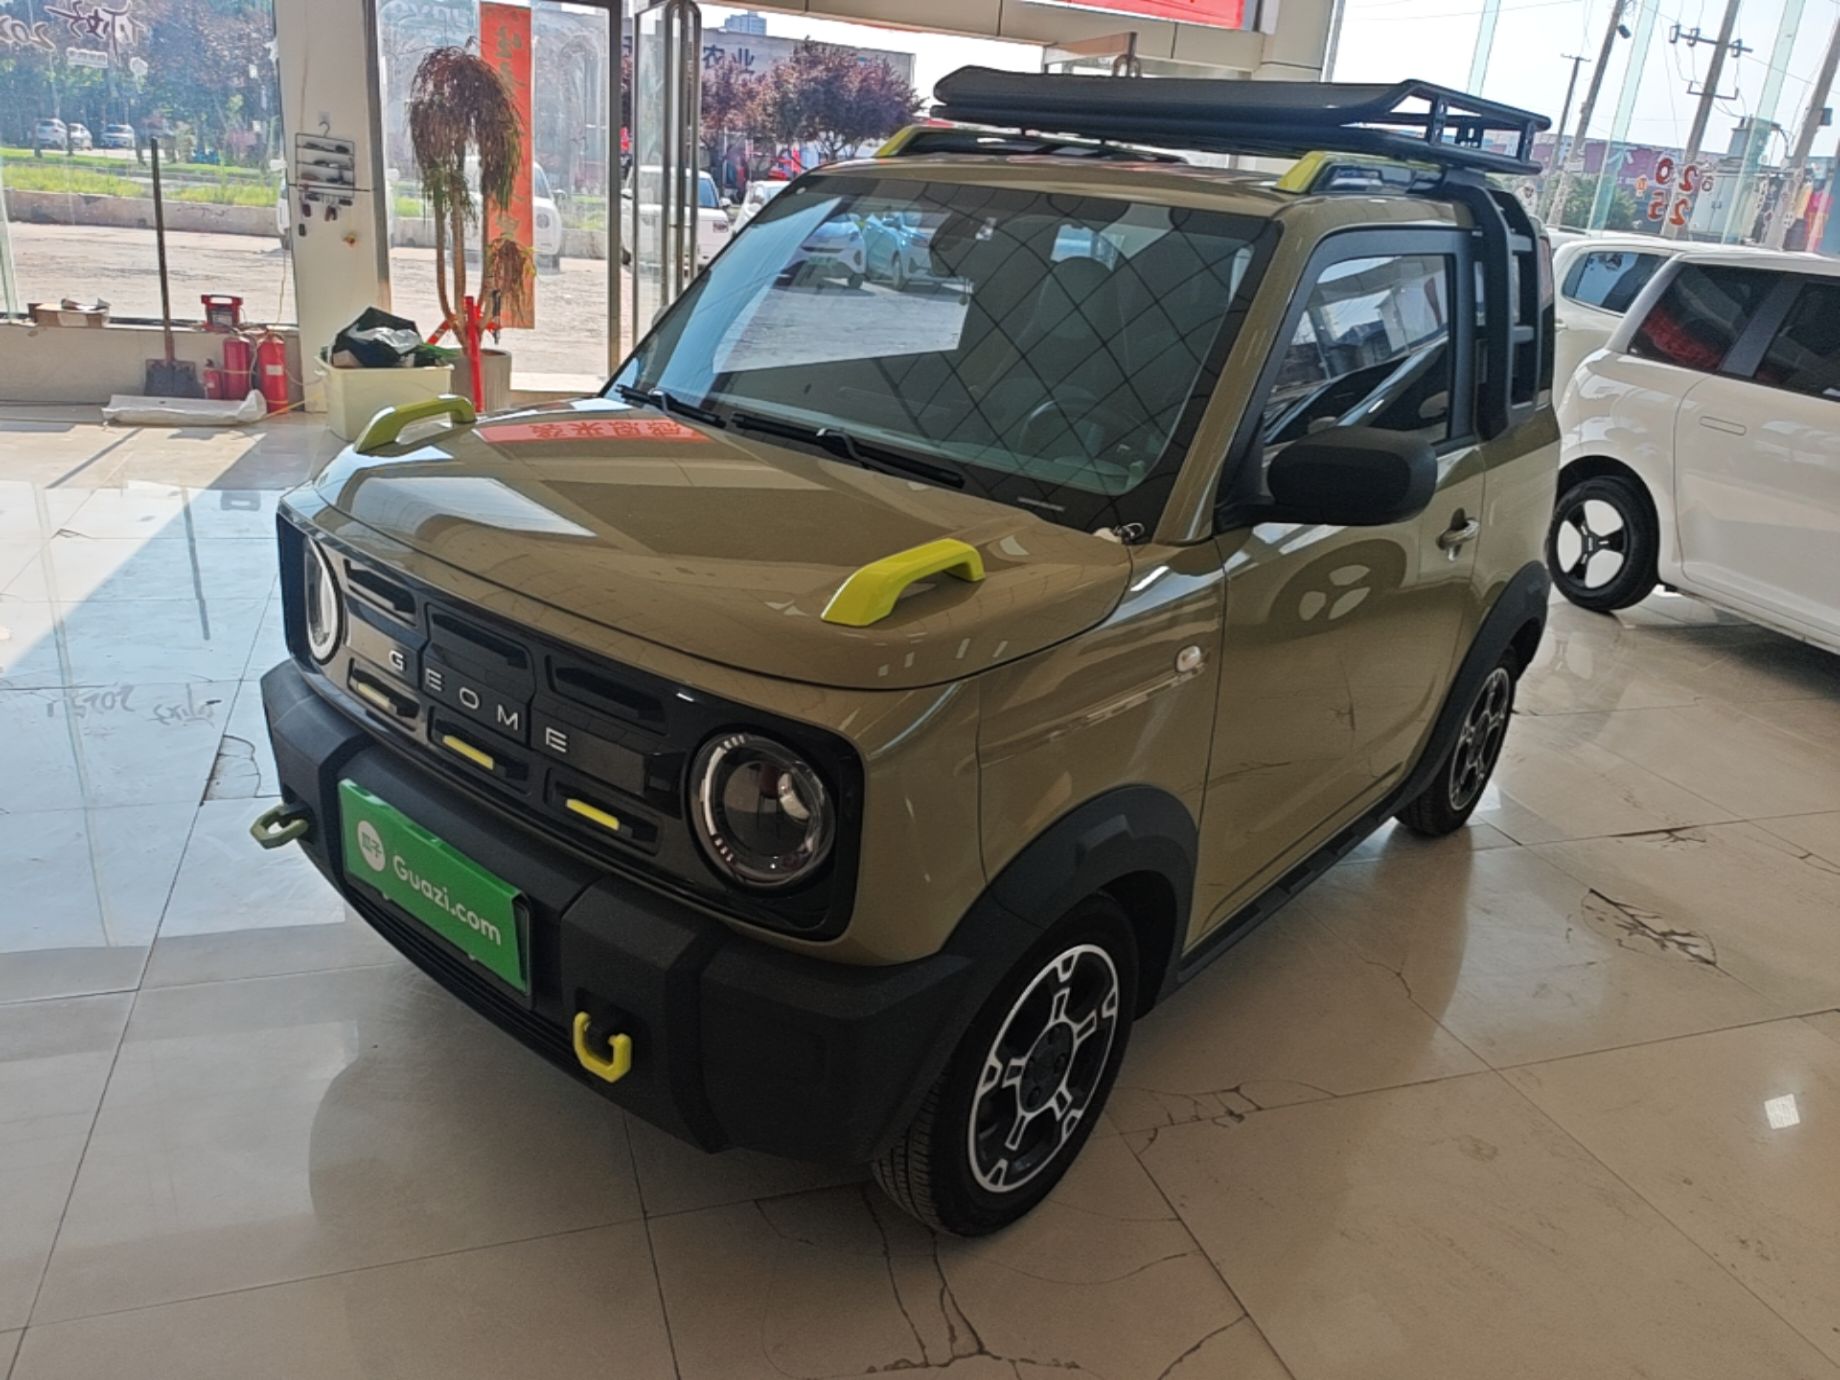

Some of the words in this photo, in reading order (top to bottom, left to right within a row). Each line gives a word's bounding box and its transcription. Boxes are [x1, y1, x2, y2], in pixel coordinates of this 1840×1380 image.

[703, 44, 756, 75] 农业
[388, 648, 568, 752] GEOME
[393, 854, 502, 946] Guazi.com
